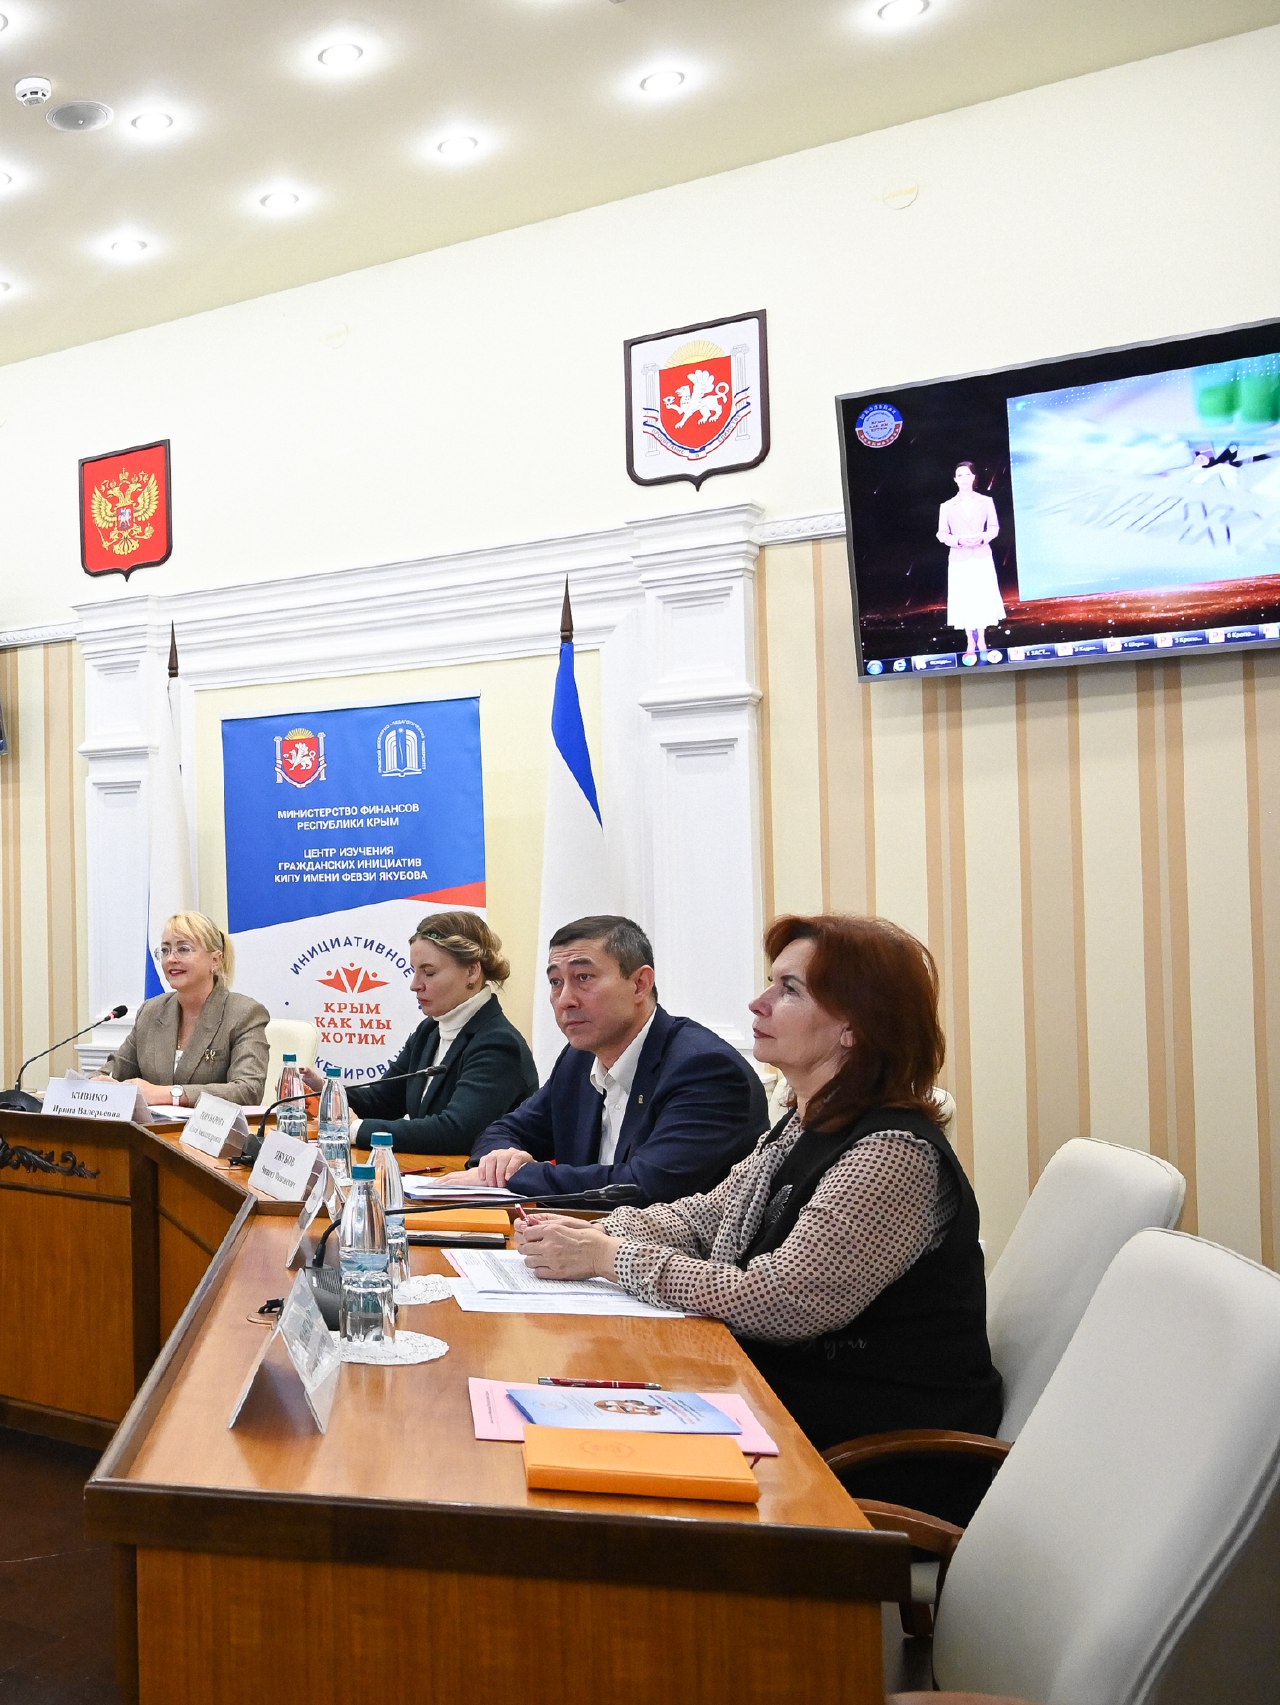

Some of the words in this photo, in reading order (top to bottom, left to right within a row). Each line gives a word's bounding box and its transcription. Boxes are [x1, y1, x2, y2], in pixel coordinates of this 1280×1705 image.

[277, 806, 358, 819] МИНИСТЕРСТВО
[360, 803, 420, 815] ФИНАНСОВ
[297, 818, 364, 831] РЕСПУБЛИКИ
[366, 817, 399, 828] КРЫМ
[303, 848, 337, 859] ЦЕНТР
[339, 846, 394, 857] ИЗУЧЕНИЯ
[278, 859, 356, 871] ГРАЖДАНСКИХ
[357, 858, 422, 869] ИНИЦИАТИВ
[274, 874, 300, 883] КИПУ
[303, 873, 340, 882] ИМЕНИ
[342, 872, 377, 882] ФЕВЗИ
[379, 870, 428, 881] ЯКУБОВА
[289, 936, 415, 979] ИНИЦИАТИВНОЕ
[323, 1002, 381, 1015] КРЫМ
[314, 1016, 352, 1029] КАК
[359, 1018, 392, 1030] МЫ
[321, 1032, 386, 1046] ХОТИМ
[274, 1150, 296, 1167] ЯКУБОВ
